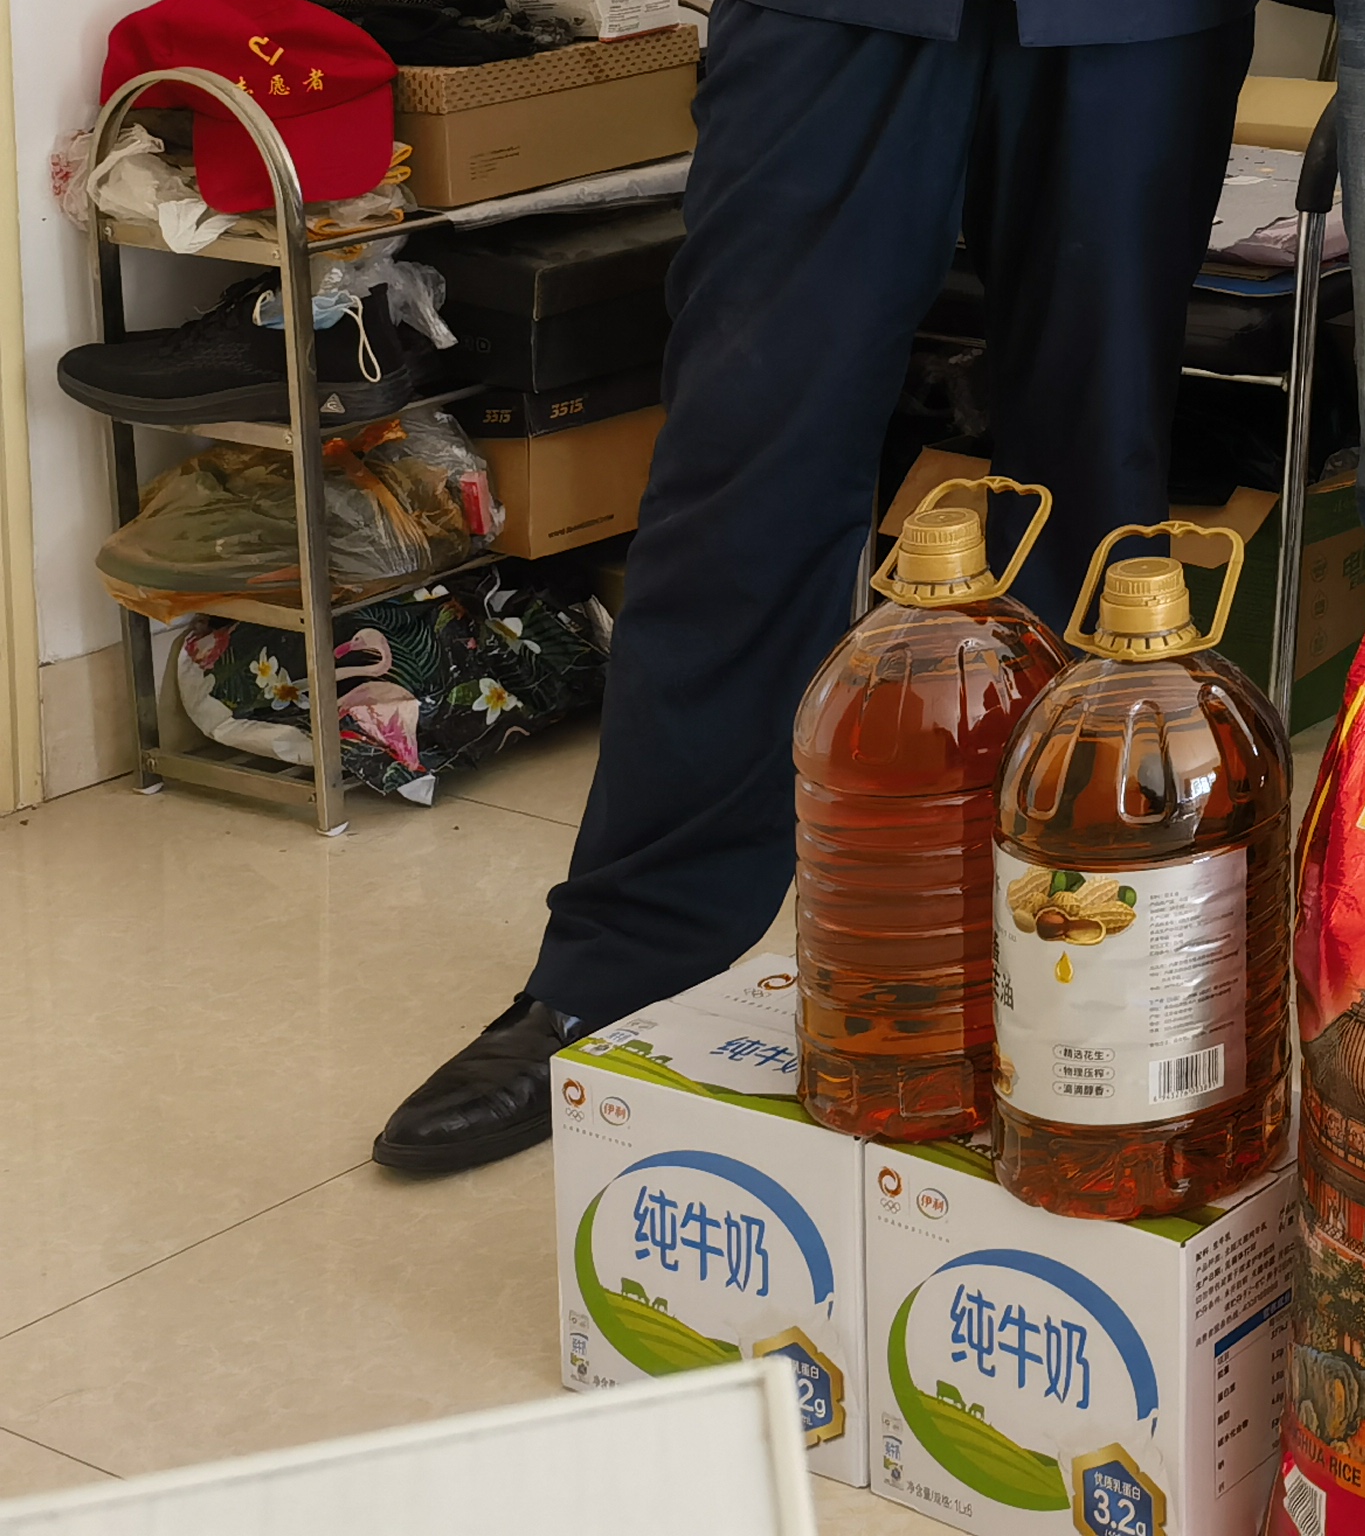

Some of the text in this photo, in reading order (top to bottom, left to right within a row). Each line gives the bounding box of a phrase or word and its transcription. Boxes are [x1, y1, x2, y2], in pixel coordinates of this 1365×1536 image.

[550, 397, 584, 419] 3515
[1063, 1047, 1104, 1061] 精选花生
[1063, 1066, 1104, 1079] 物理压榨
[633, 1185, 769, 1297] 纯牛奶
[950, 1283, 1090, 1410] 纯牛奶
[1093, 1470, 1141, 1501] 优质乳蛋白
[1329, 1455, 1362, 1488] RICE
